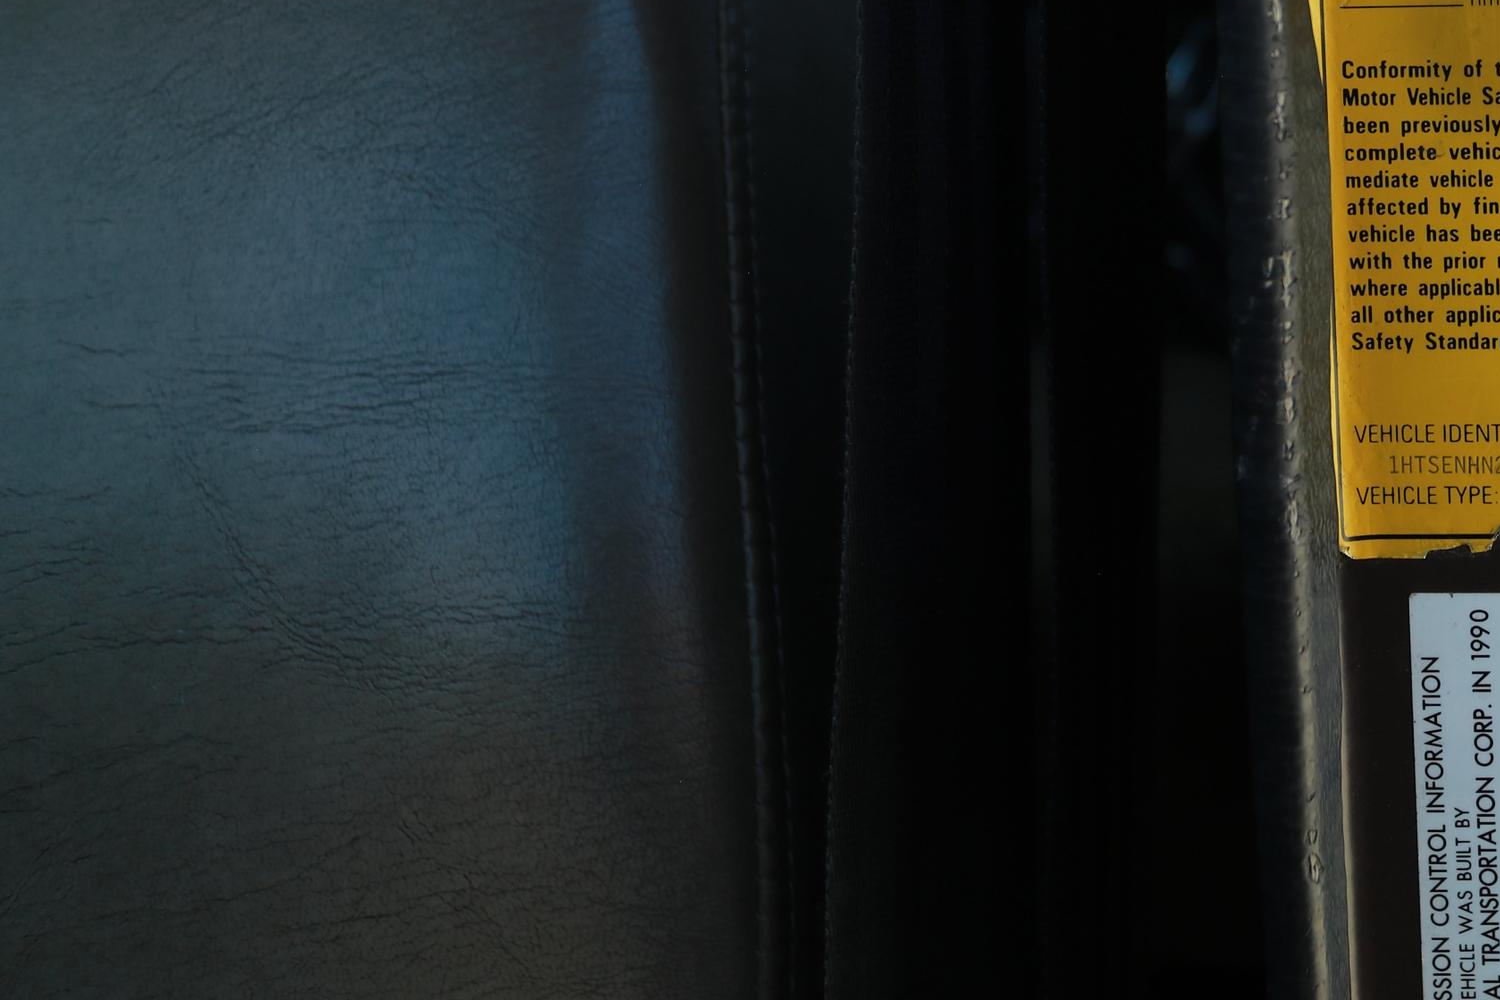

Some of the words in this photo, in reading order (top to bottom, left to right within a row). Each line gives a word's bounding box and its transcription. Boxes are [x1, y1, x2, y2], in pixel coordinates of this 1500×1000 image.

[1342, 58, 1452, 82] Conformity
[1464, 59, 1483, 78] of
[1343, 89, 1395, 107] Motor
[1407, 87, 1471, 106] Vehicle
[1345, 144, 1437, 165] complete
[1347, 198, 1429, 216] affected
[1440, 197, 1462, 219] by
[1349, 251, 1392, 270] with
[1403, 251, 1432, 269] the
[1443, 251, 1486, 273] prior
[1351, 306, 1373, 324] all
[1384, 304, 1434, 323] other
[1351, 331, 1414, 352] Safety
[1354, 423, 1436, 443] VEHICLE
[1356, 485, 1439, 505] VEHICLE
[1443, 485, 1499, 505] TYPE:
[1470, 609, 1490, 661] 1990
[1472, 671, 1492, 693] IN
[1420, 656, 1445, 813] INFORMATION
[1473, 704, 1496, 767] CORP.
[1454, 808, 1471, 830] BY
[1456, 837, 1472, 881] BUILT
[1424, 824, 1450, 926] CONTROL
[1476, 777, 1500, 966] TRANSPORTATION
[1458, 891, 1474, 935] WAS
